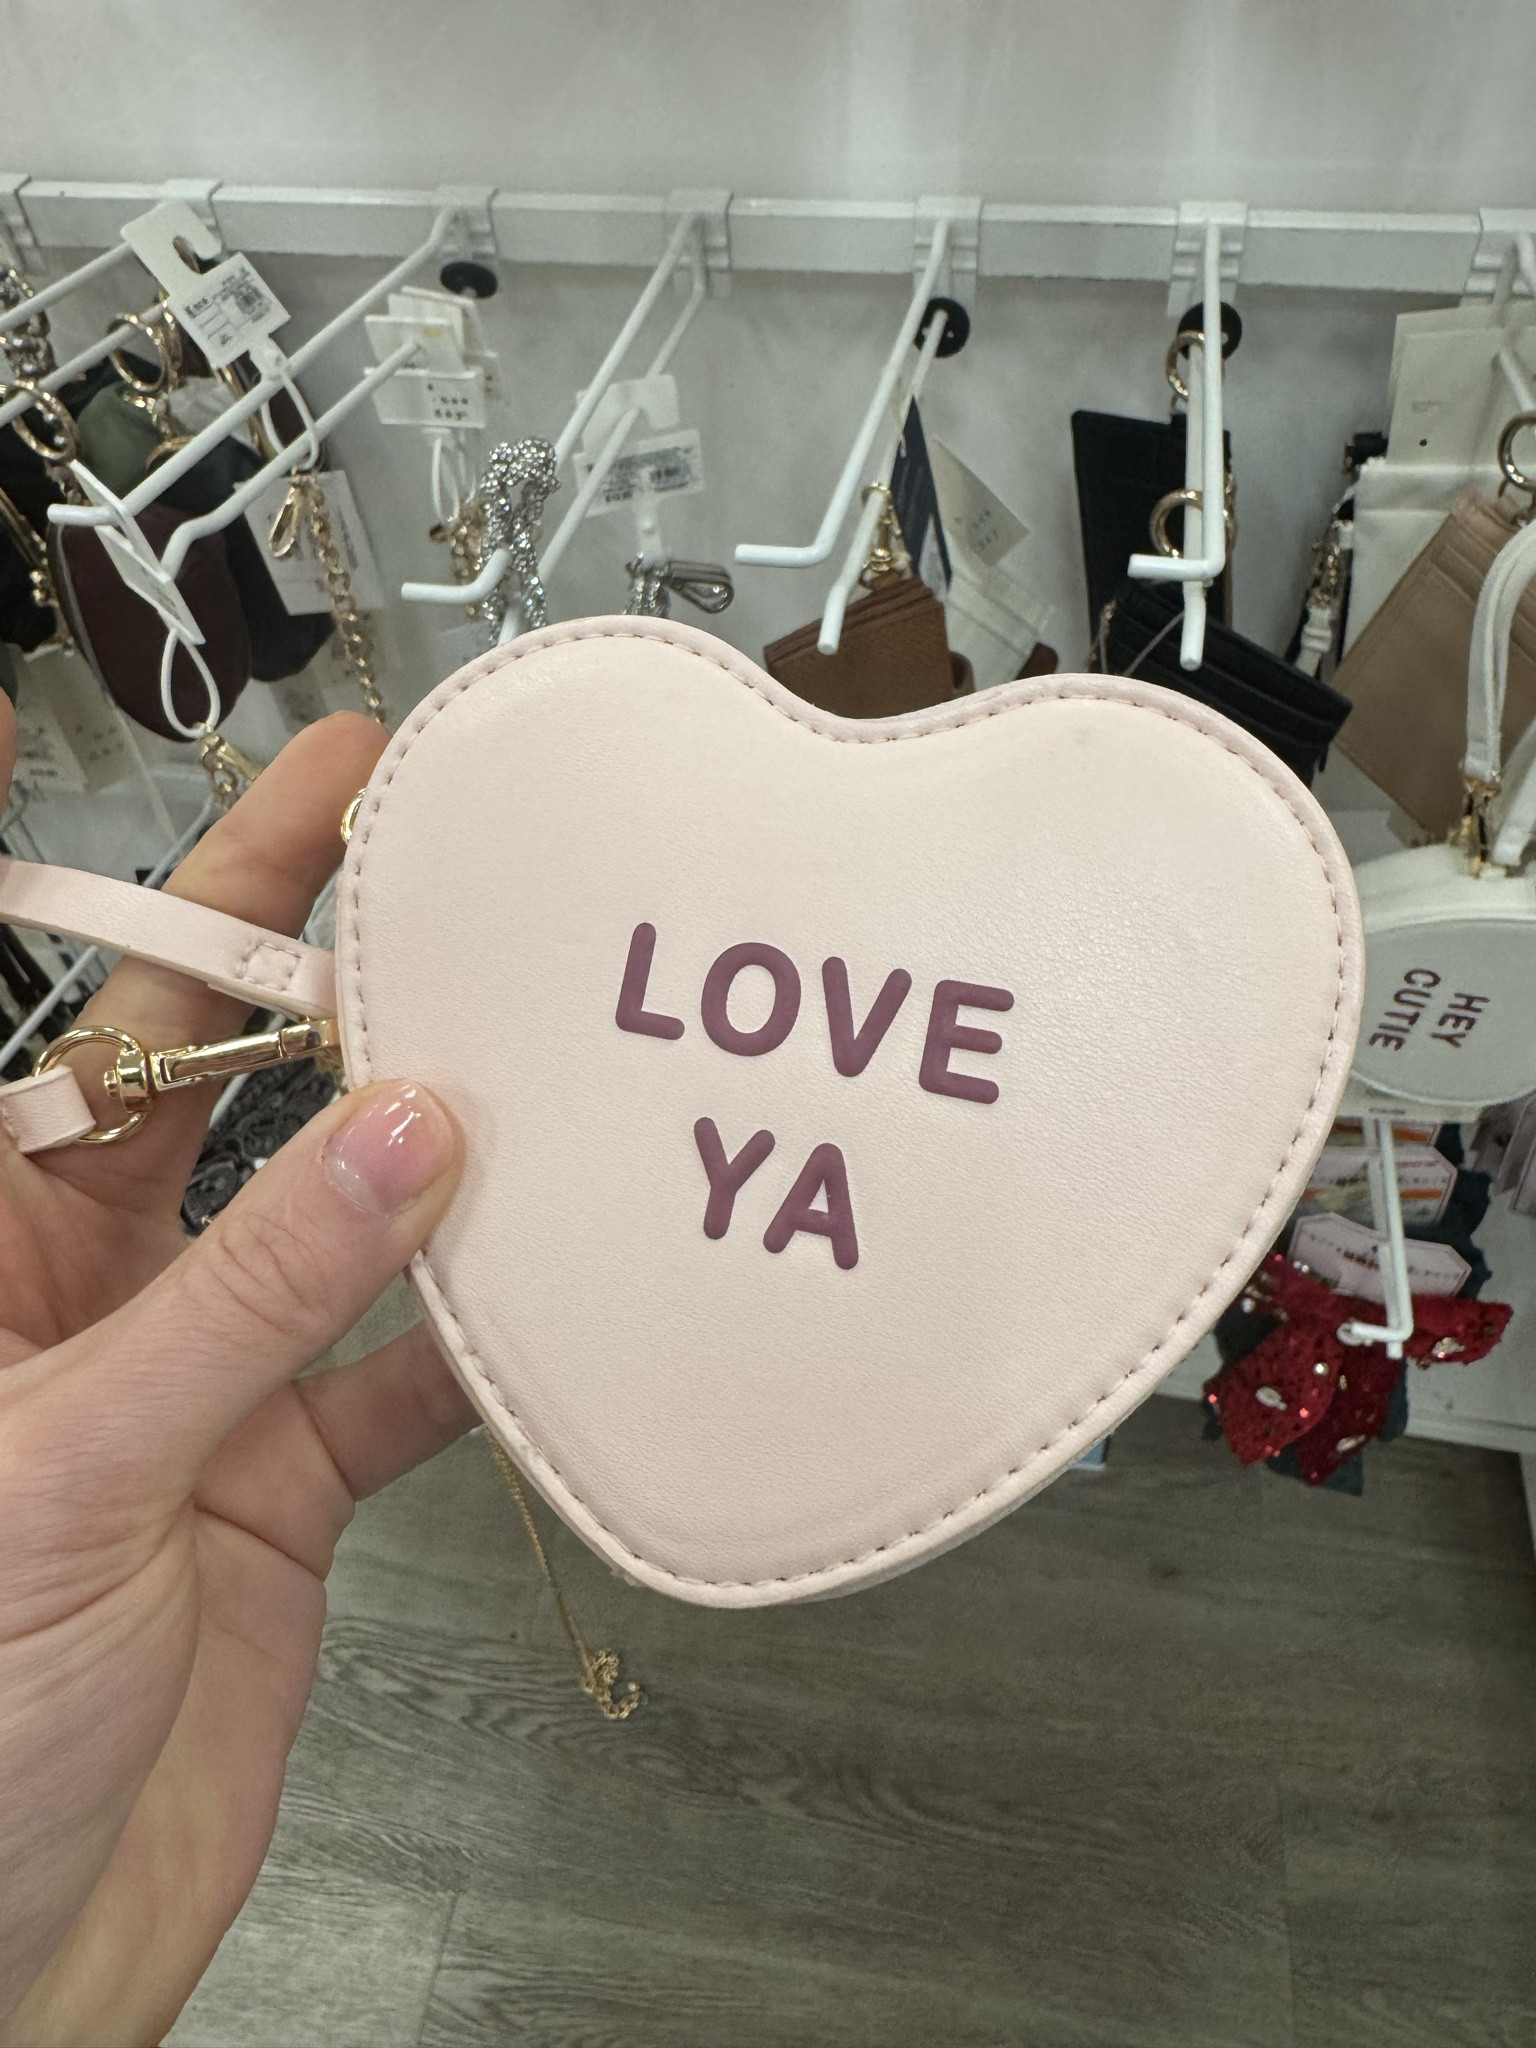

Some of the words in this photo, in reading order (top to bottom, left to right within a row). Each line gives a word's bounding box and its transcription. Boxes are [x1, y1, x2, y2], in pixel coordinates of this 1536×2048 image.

[616, 922, 1015, 1105] LOVE
[1368, 967, 1441, 1052] CUTIE
[1430, 992, 1490, 1049] HEY
[694, 1116, 860, 1271] YA
